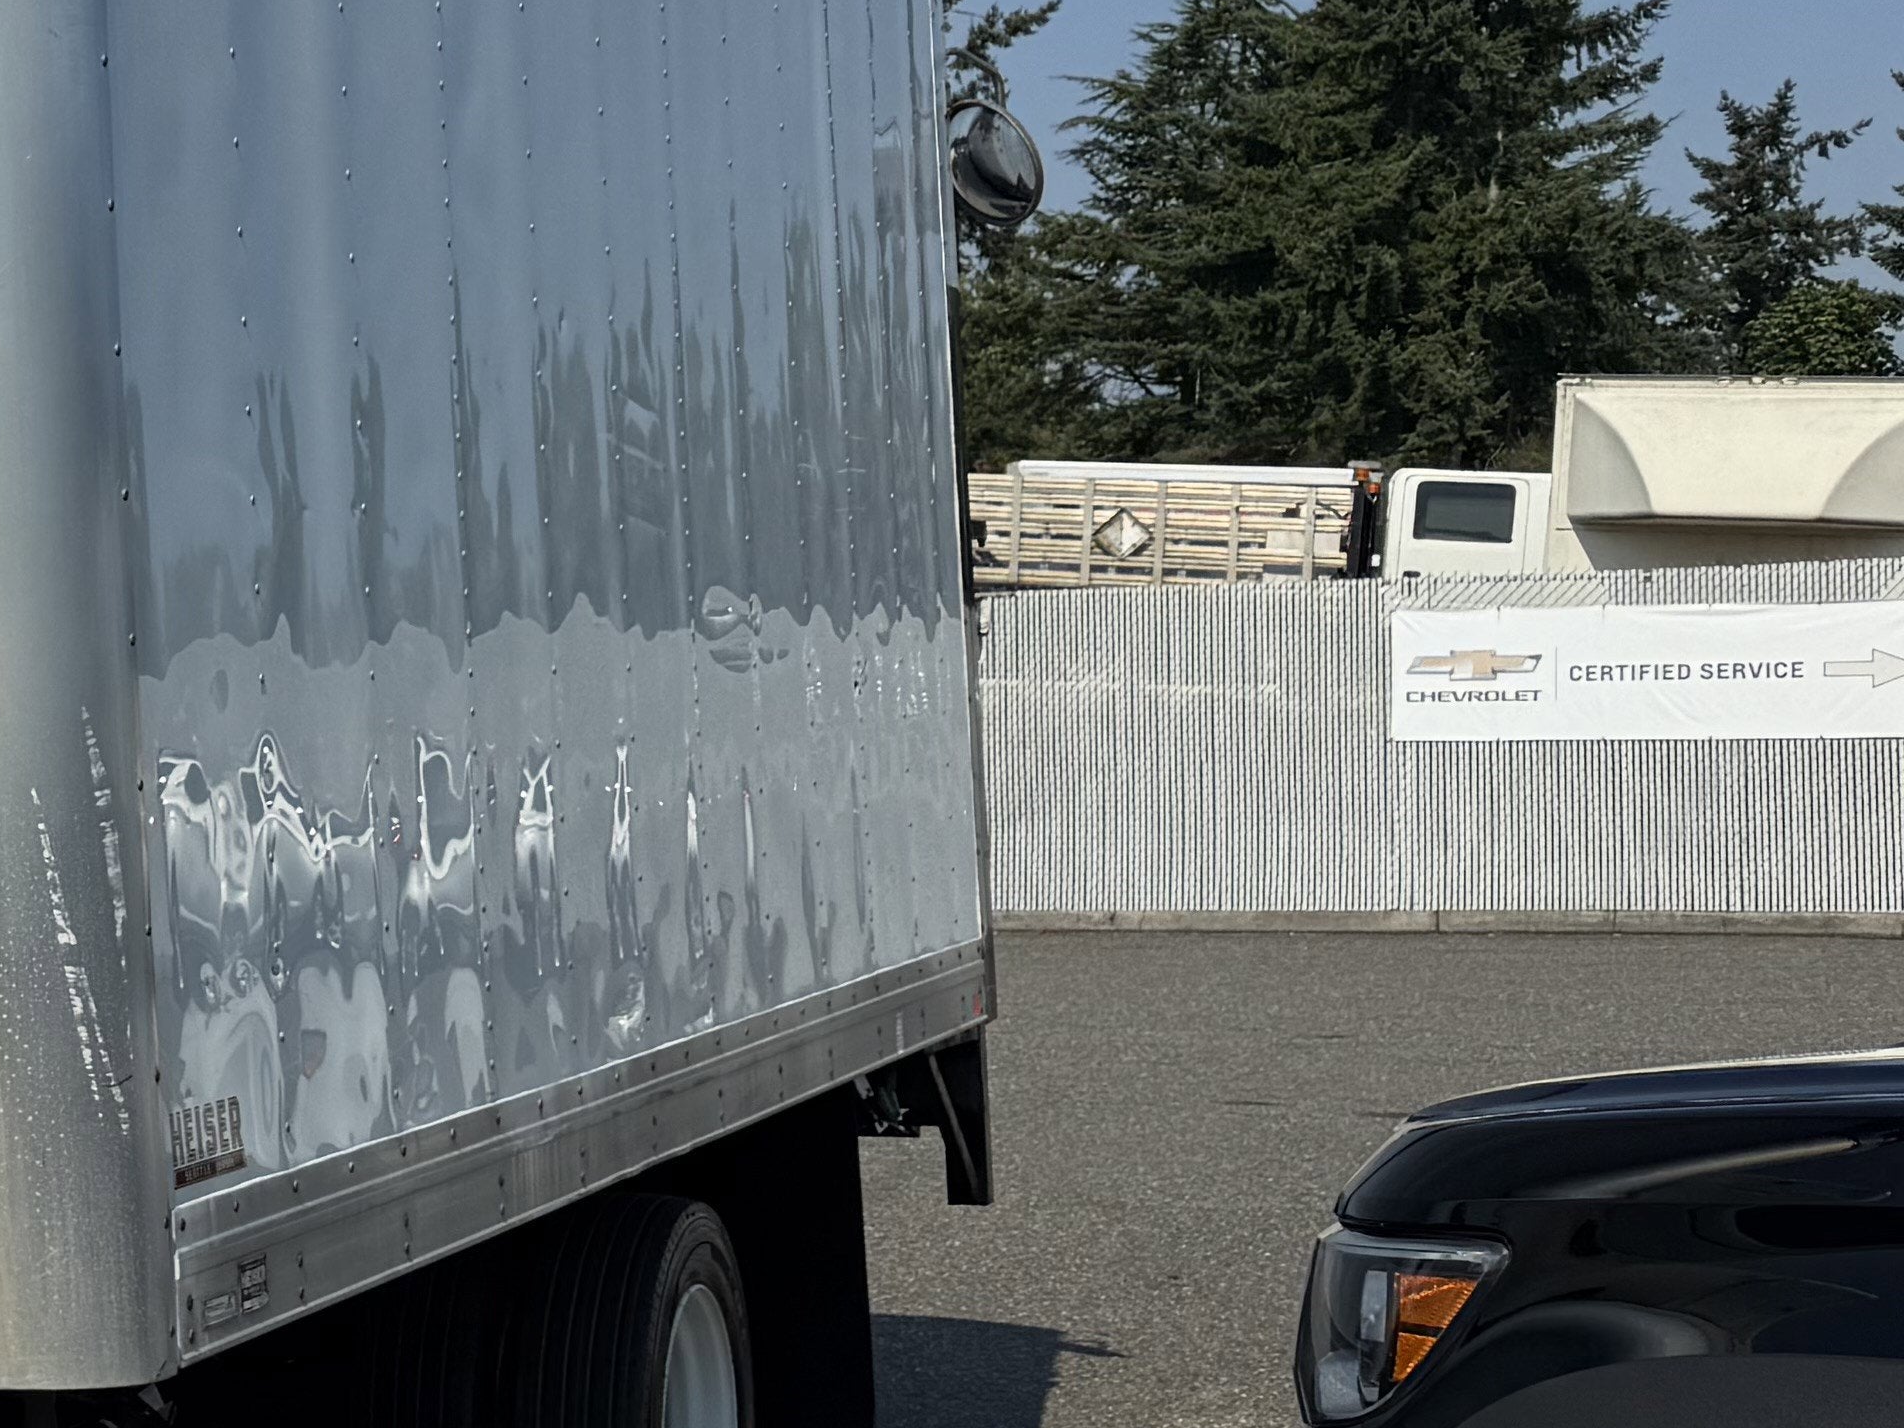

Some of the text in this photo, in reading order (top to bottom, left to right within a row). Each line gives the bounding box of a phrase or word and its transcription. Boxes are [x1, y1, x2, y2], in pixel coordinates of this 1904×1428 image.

[1569, 661, 1805, 682] CERTIFIED SERVICE
[1405, 689, 1542, 703] CHEVROLET
[169, 1096, 244, 1168] HEISER
